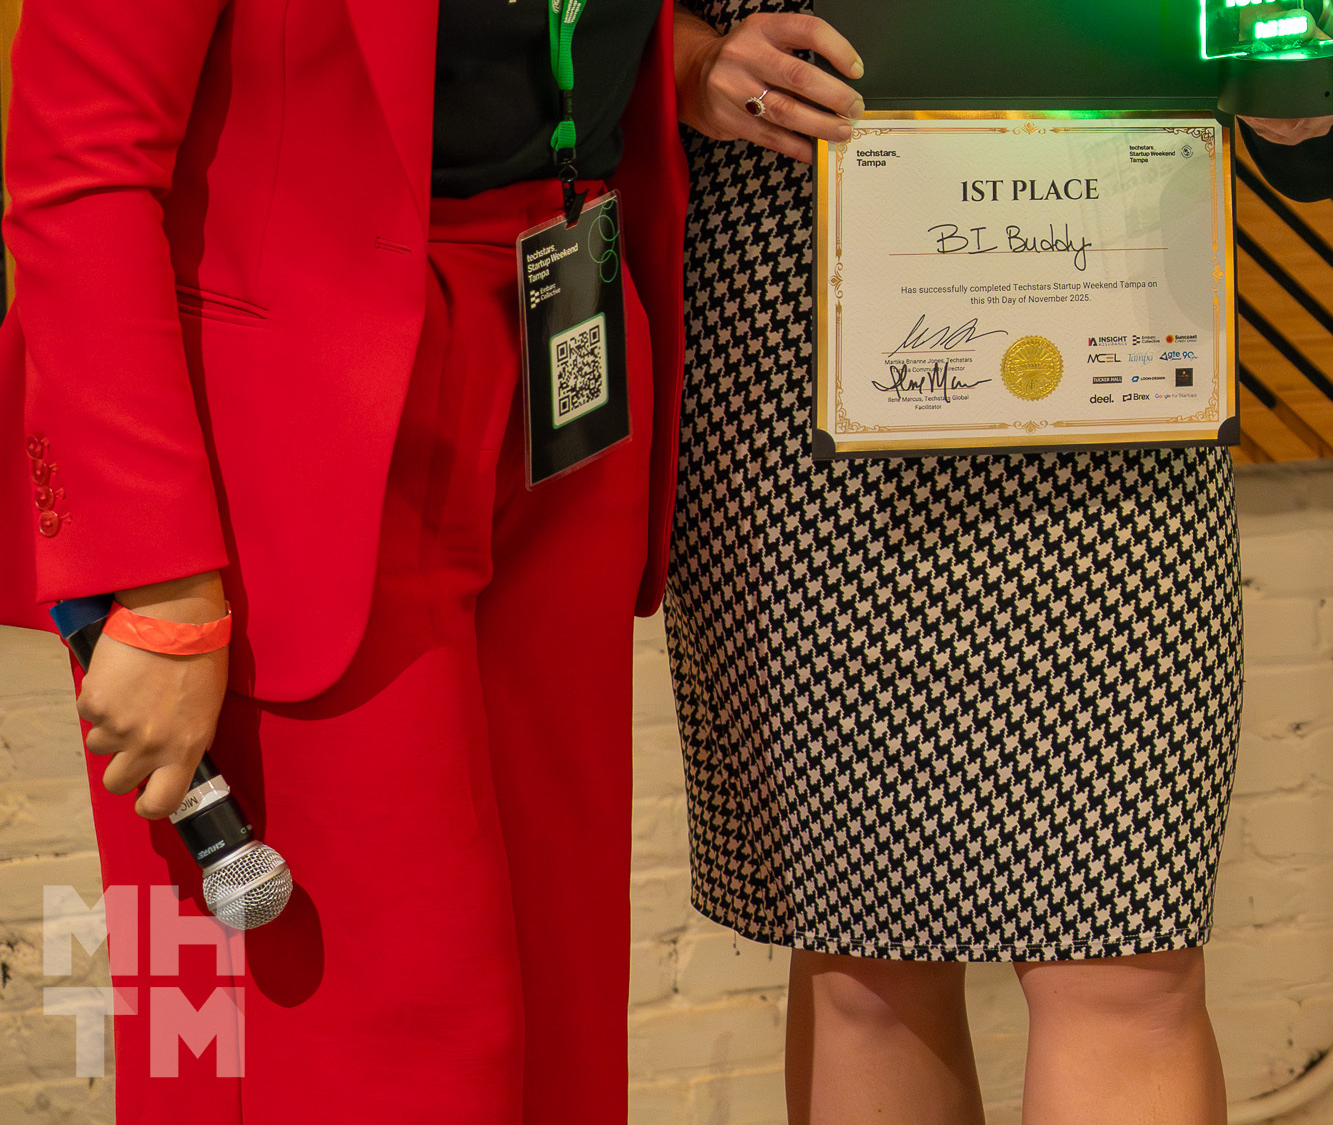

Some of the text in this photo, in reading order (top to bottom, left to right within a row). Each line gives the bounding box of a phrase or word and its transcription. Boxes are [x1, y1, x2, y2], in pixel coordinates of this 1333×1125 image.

[856, 159, 886, 168] Tampa
[961, 178, 1100, 202] 1ST PLACE
[928, 223, 1092, 271] BI Buddy
[527, 242, 579, 273] Startup Weekend
[528, 268, 550, 283] Tampa
[900, 286, 917, 294] Has
[918, 284, 968, 295] successfully
[969, 283, 1011, 294] completed
[1012, 283, 1051, 291] Techstars
[1052, 282, 1081, 291] Startup
[1082, 280, 1118, 290] Weekend
[1119, 280, 1146, 289] Tampa
[970, 293, 1091, 306] this 9th Day of November 2025.
[1089, 394, 1114, 404] deel.
[1133, 393, 1150, 401] Brex
[181, 795, 199, 812] MIC
[197, 839, 226, 860] SHURE
